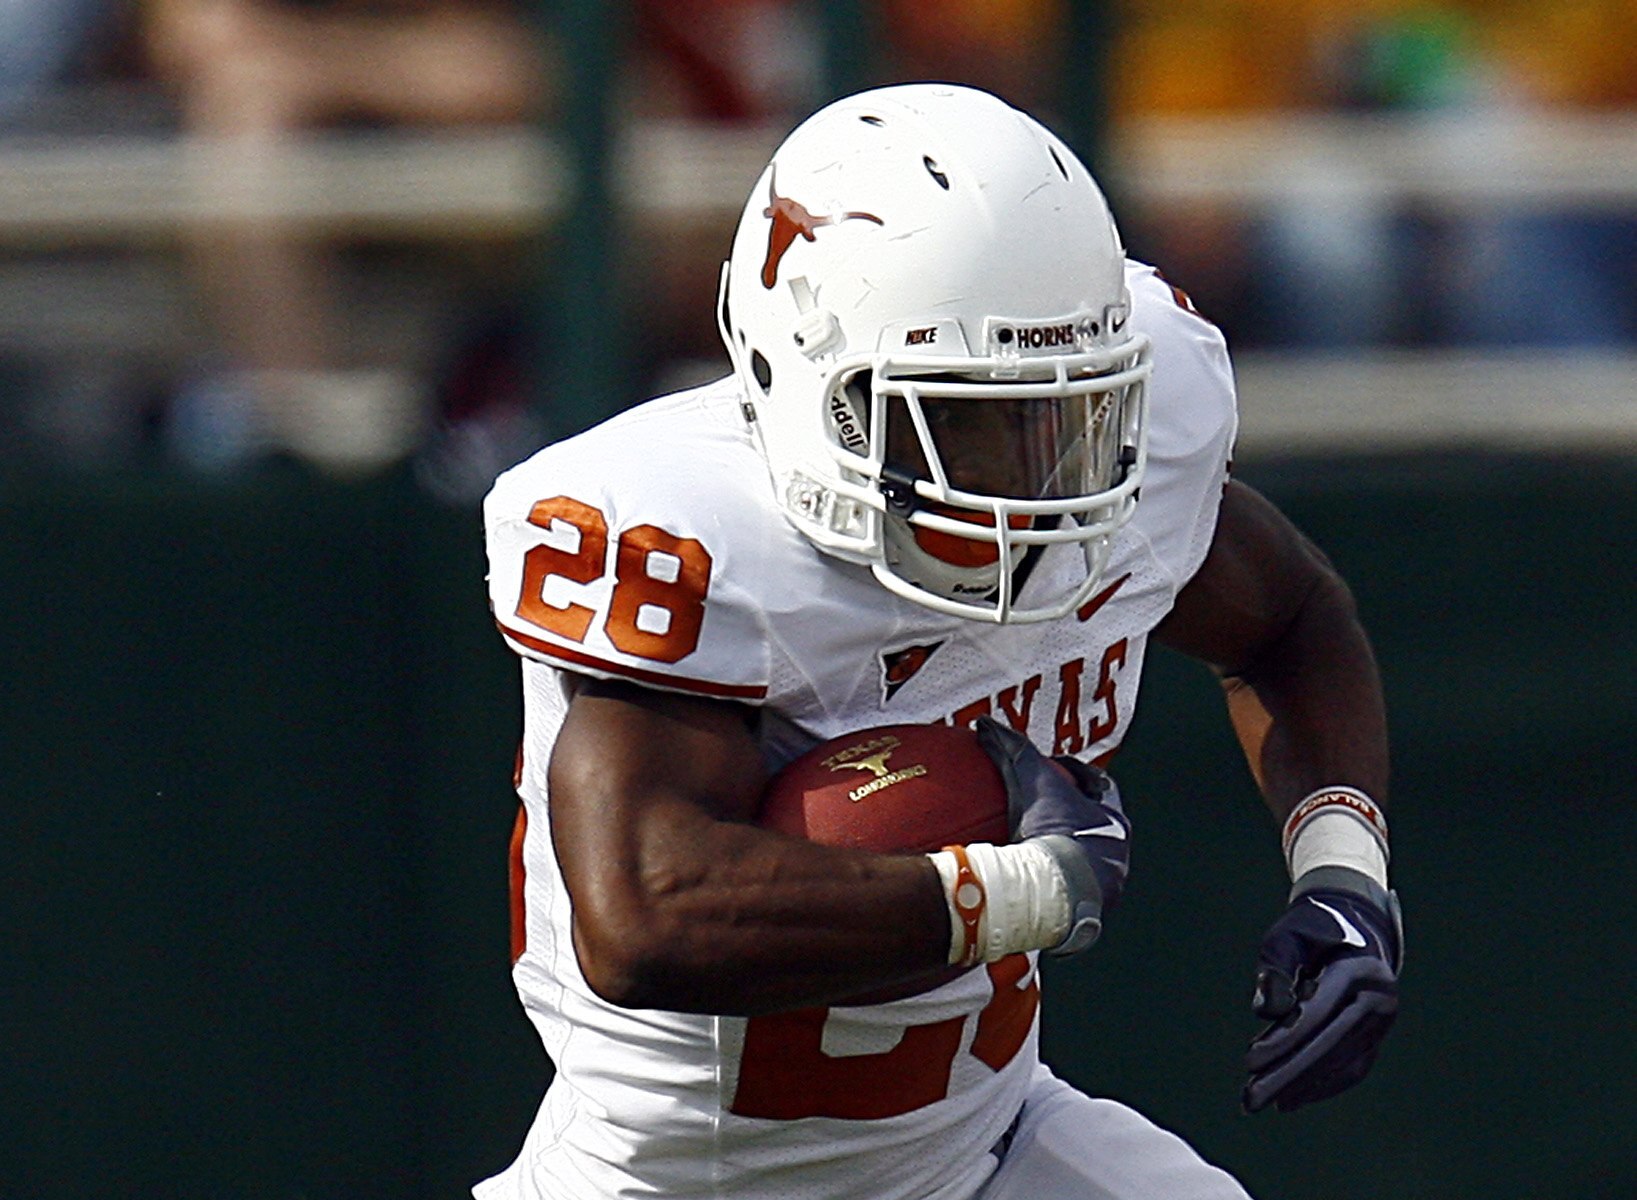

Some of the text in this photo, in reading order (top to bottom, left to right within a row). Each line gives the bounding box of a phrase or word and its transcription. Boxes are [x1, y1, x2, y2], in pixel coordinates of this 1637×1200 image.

[905, 327, 937, 346] NIKE
[1017, 323, 1074, 348] HORNS
[831, 395, 864, 447] ddell
[514, 495, 713, 664] 28
[930, 637, 1128, 756] YAS
